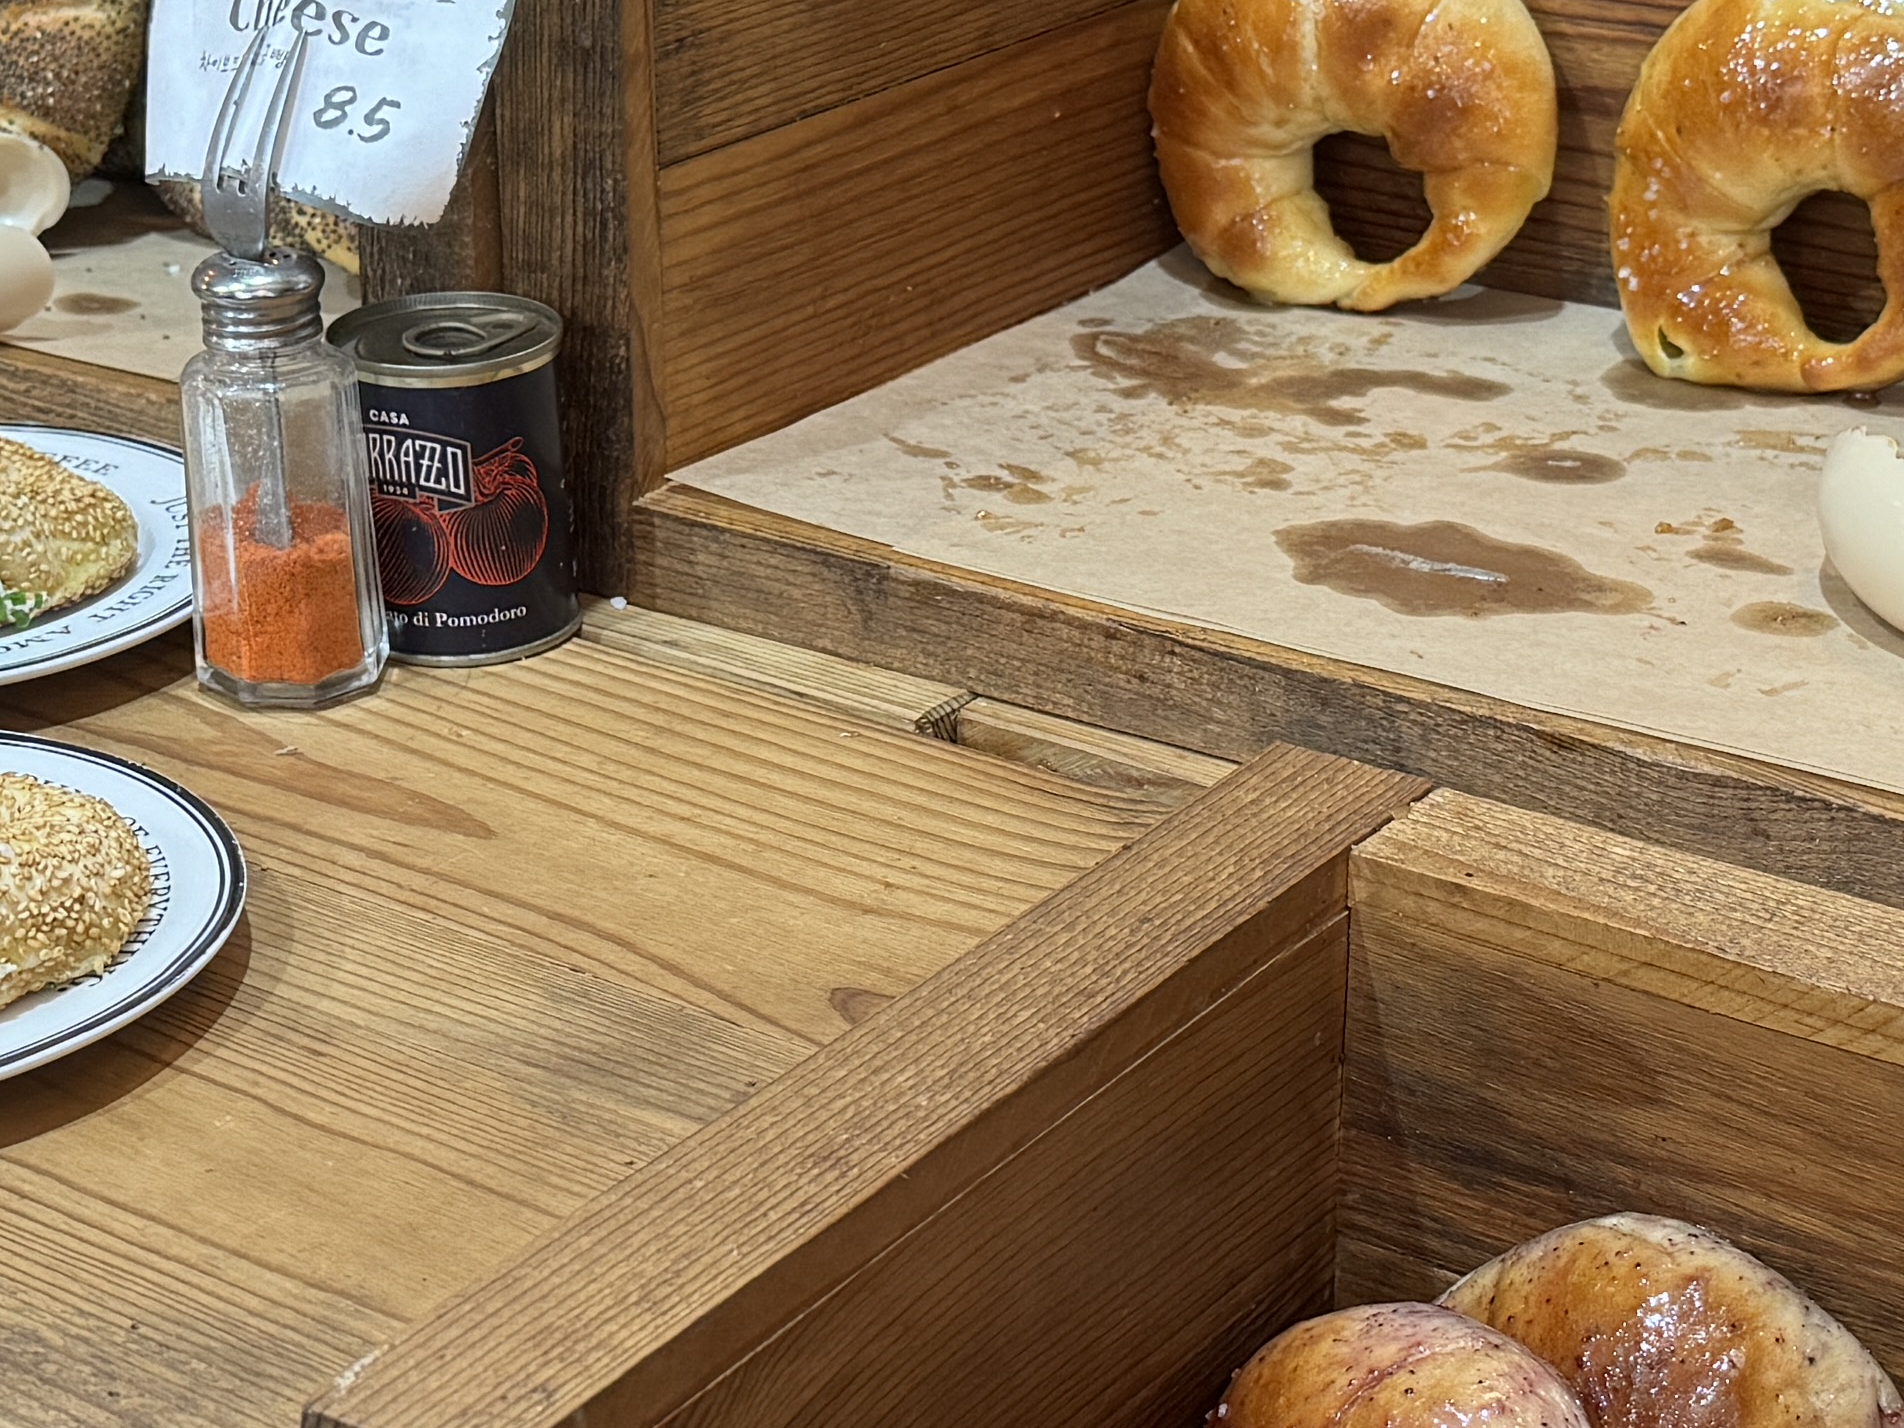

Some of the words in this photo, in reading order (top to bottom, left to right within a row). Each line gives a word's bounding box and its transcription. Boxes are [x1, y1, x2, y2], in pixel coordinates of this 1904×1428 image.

[312, 85, 402, 144] 8.5
[369, 409, 410, 426] CASA
[368, 433, 466, 495] RRAZZO
[413, 611, 430, 627] di
[435, 605, 527, 628] Pomodoro
